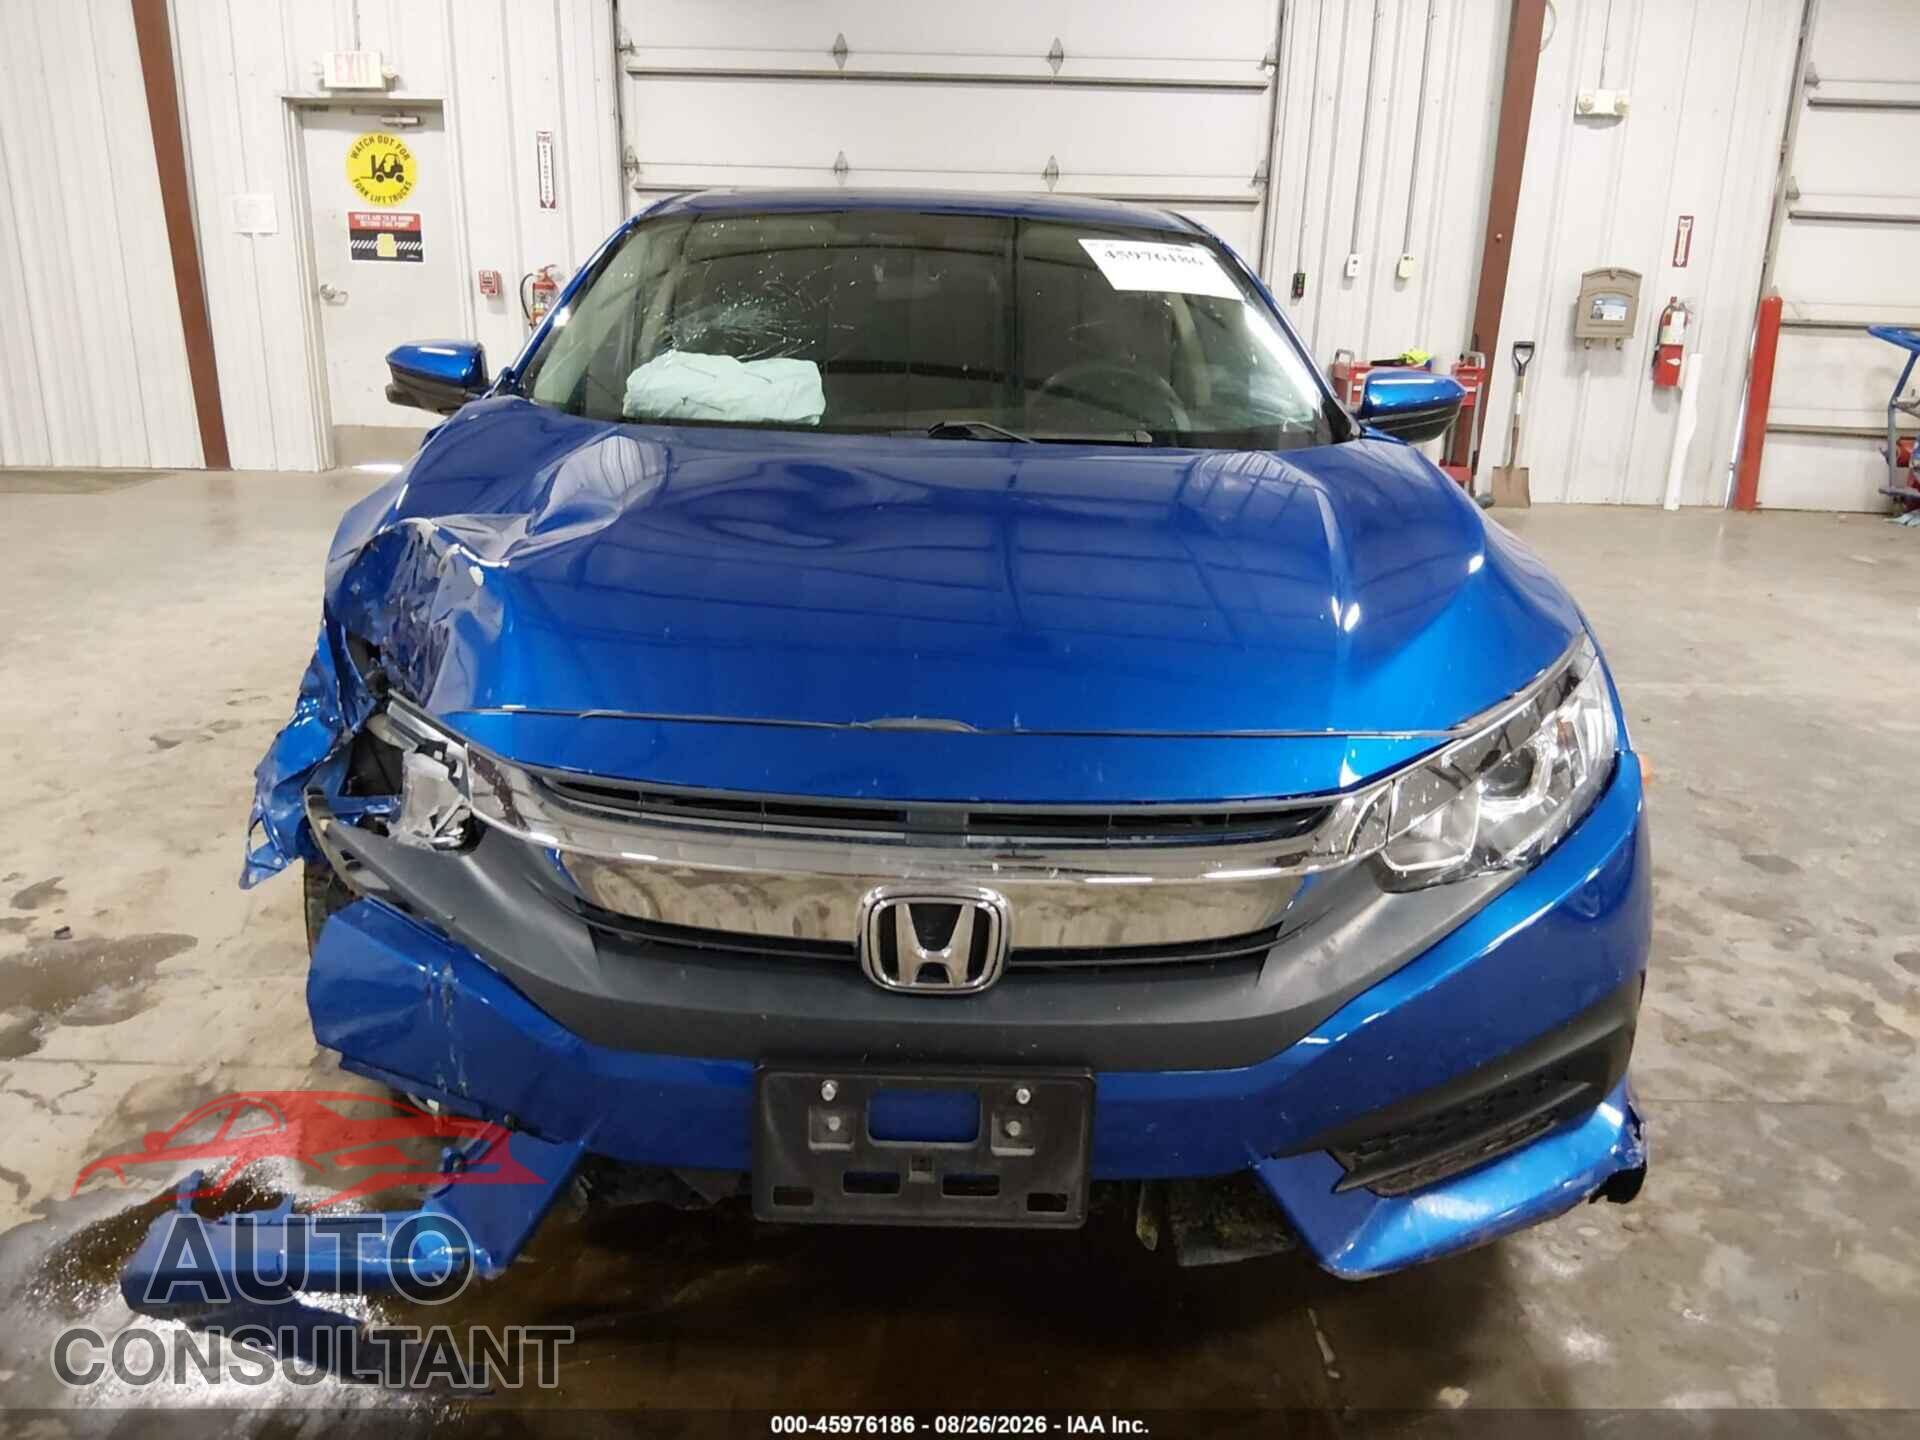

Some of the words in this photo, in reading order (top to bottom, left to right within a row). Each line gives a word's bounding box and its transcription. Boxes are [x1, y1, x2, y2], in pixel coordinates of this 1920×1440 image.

[350, 136, 375, 159] WATCH
[377, 135, 395, 145] OUT
[395, 143, 411, 160] FOR
[353, 178, 369, 196] FORK
[370, 194, 386, 204] LIFT
[388, 180, 412, 203] TRUCKS
